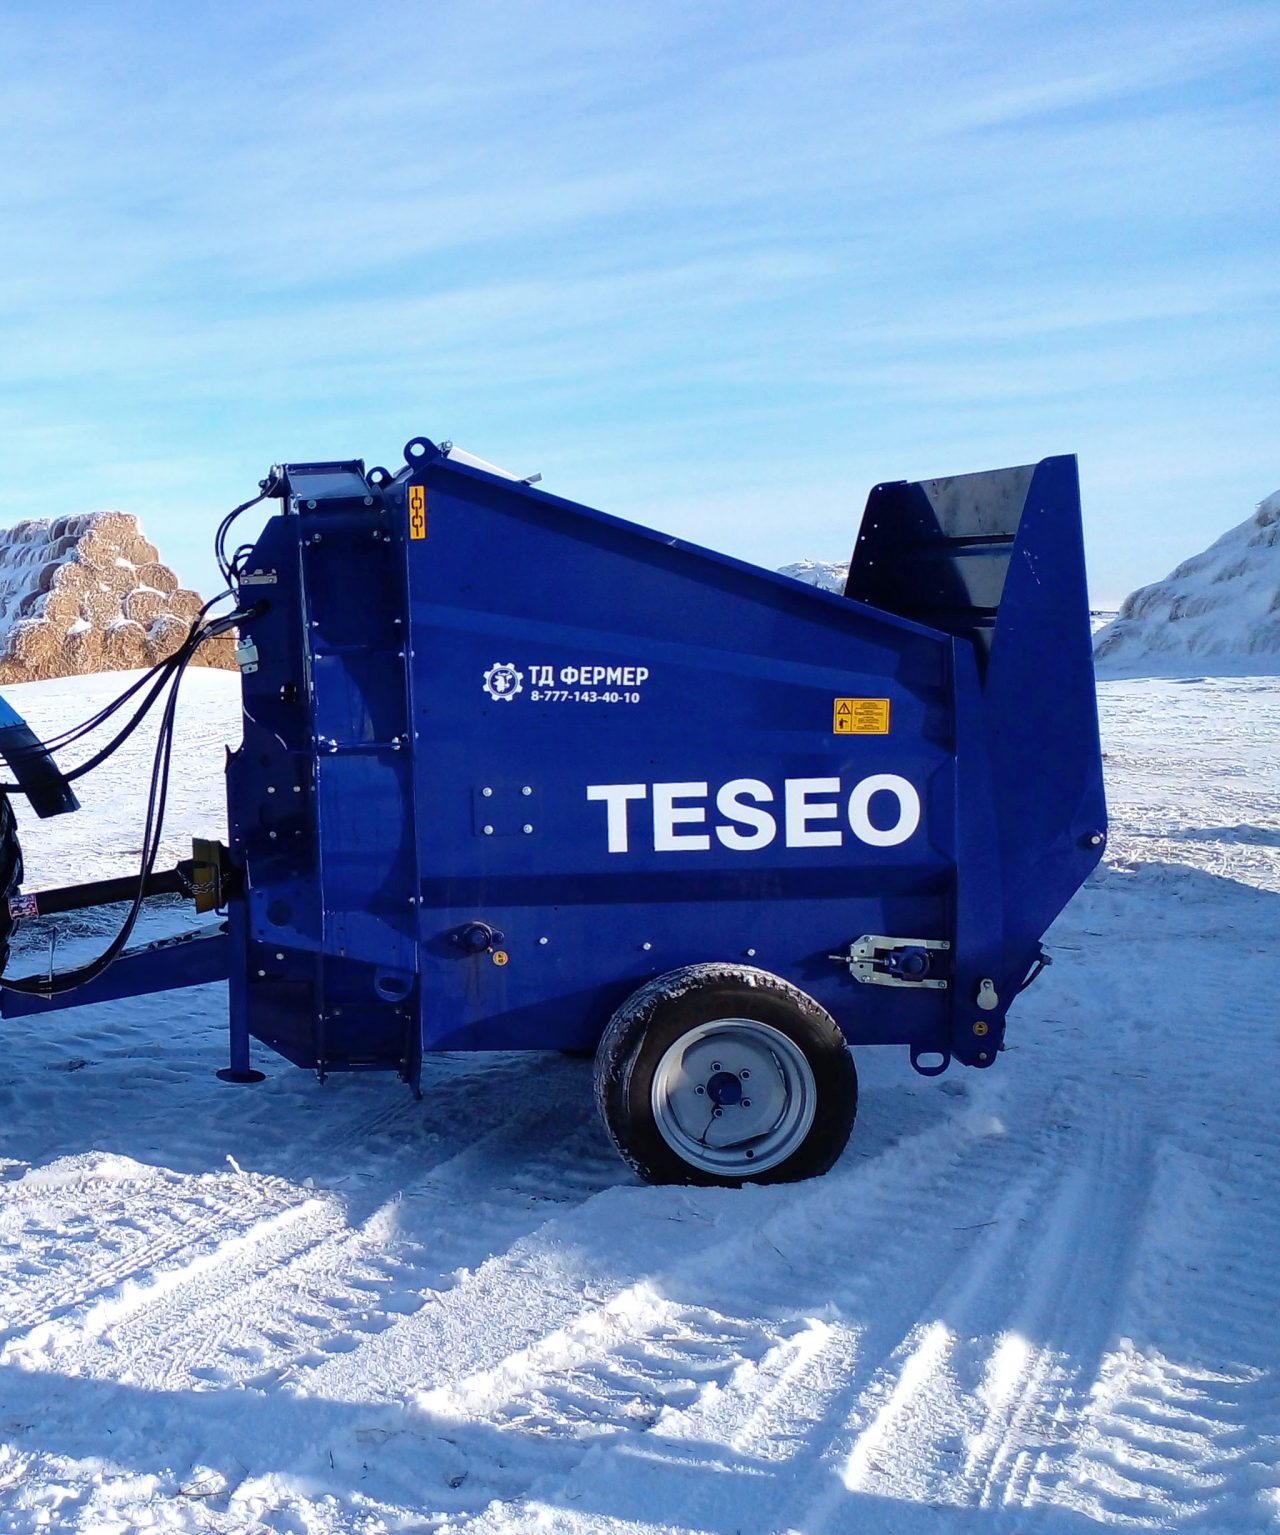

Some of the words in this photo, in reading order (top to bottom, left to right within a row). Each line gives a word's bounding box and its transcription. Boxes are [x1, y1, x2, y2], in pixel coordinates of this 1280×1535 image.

[528, 665, 555, 687] ТД
[560, 665, 649, 686] ФЕРМЕР
[530, 690, 640, 704] 8-777-143-40-10
[586, 773, 921, 853] TESEO
